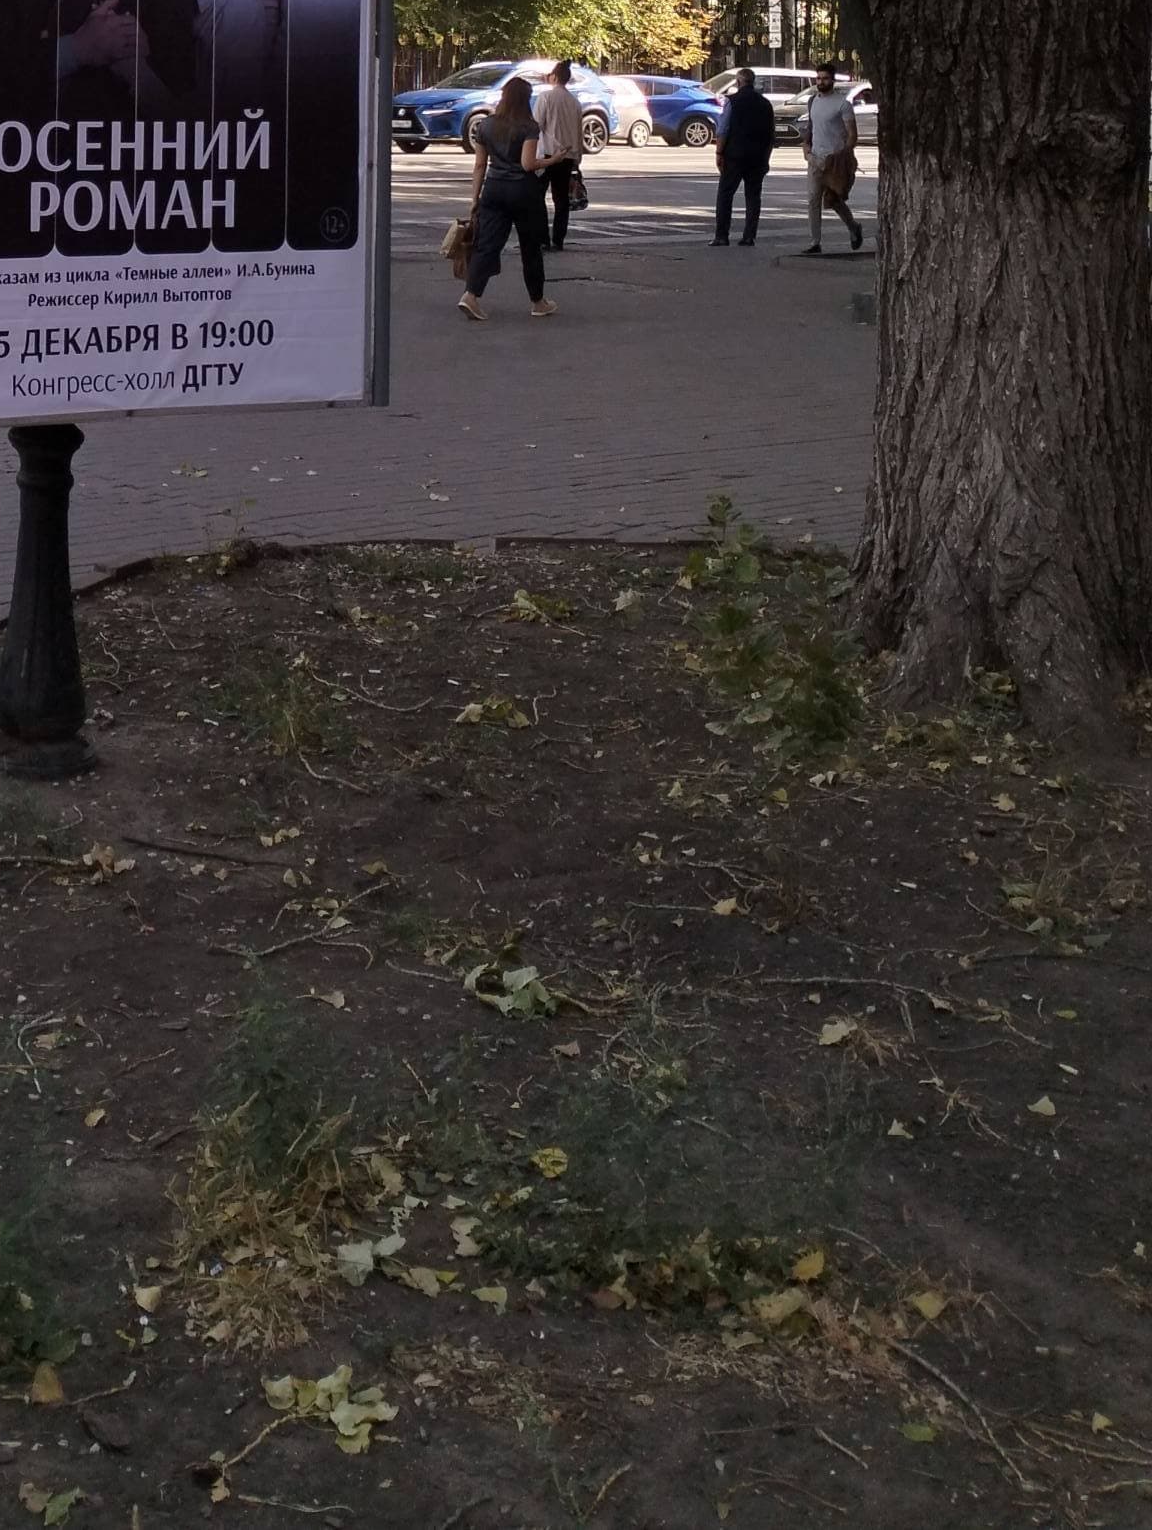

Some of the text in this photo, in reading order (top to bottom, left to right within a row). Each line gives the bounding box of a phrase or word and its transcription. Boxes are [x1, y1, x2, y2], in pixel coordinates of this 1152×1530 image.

[29, 179, 236, 233] РОМАН
[44, 270, 61, 284] из
[65, 269, 110, 285] цикла
[115, 266, 178, 281] «Темные
[182, 265, 232, 279] аллеи»
[237, 262, 316, 281] И.А.Бунина
[28, 288, 232, 310] Режиссер Кирилл Вытоптов
[20, 323, 160, 364] ДЕКАБРЯ
[171, 323, 189, 350] В
[198, 319, 274, 349] 19:00
[12, 362, 244, 402] Конгресс-холл ДГТУ
